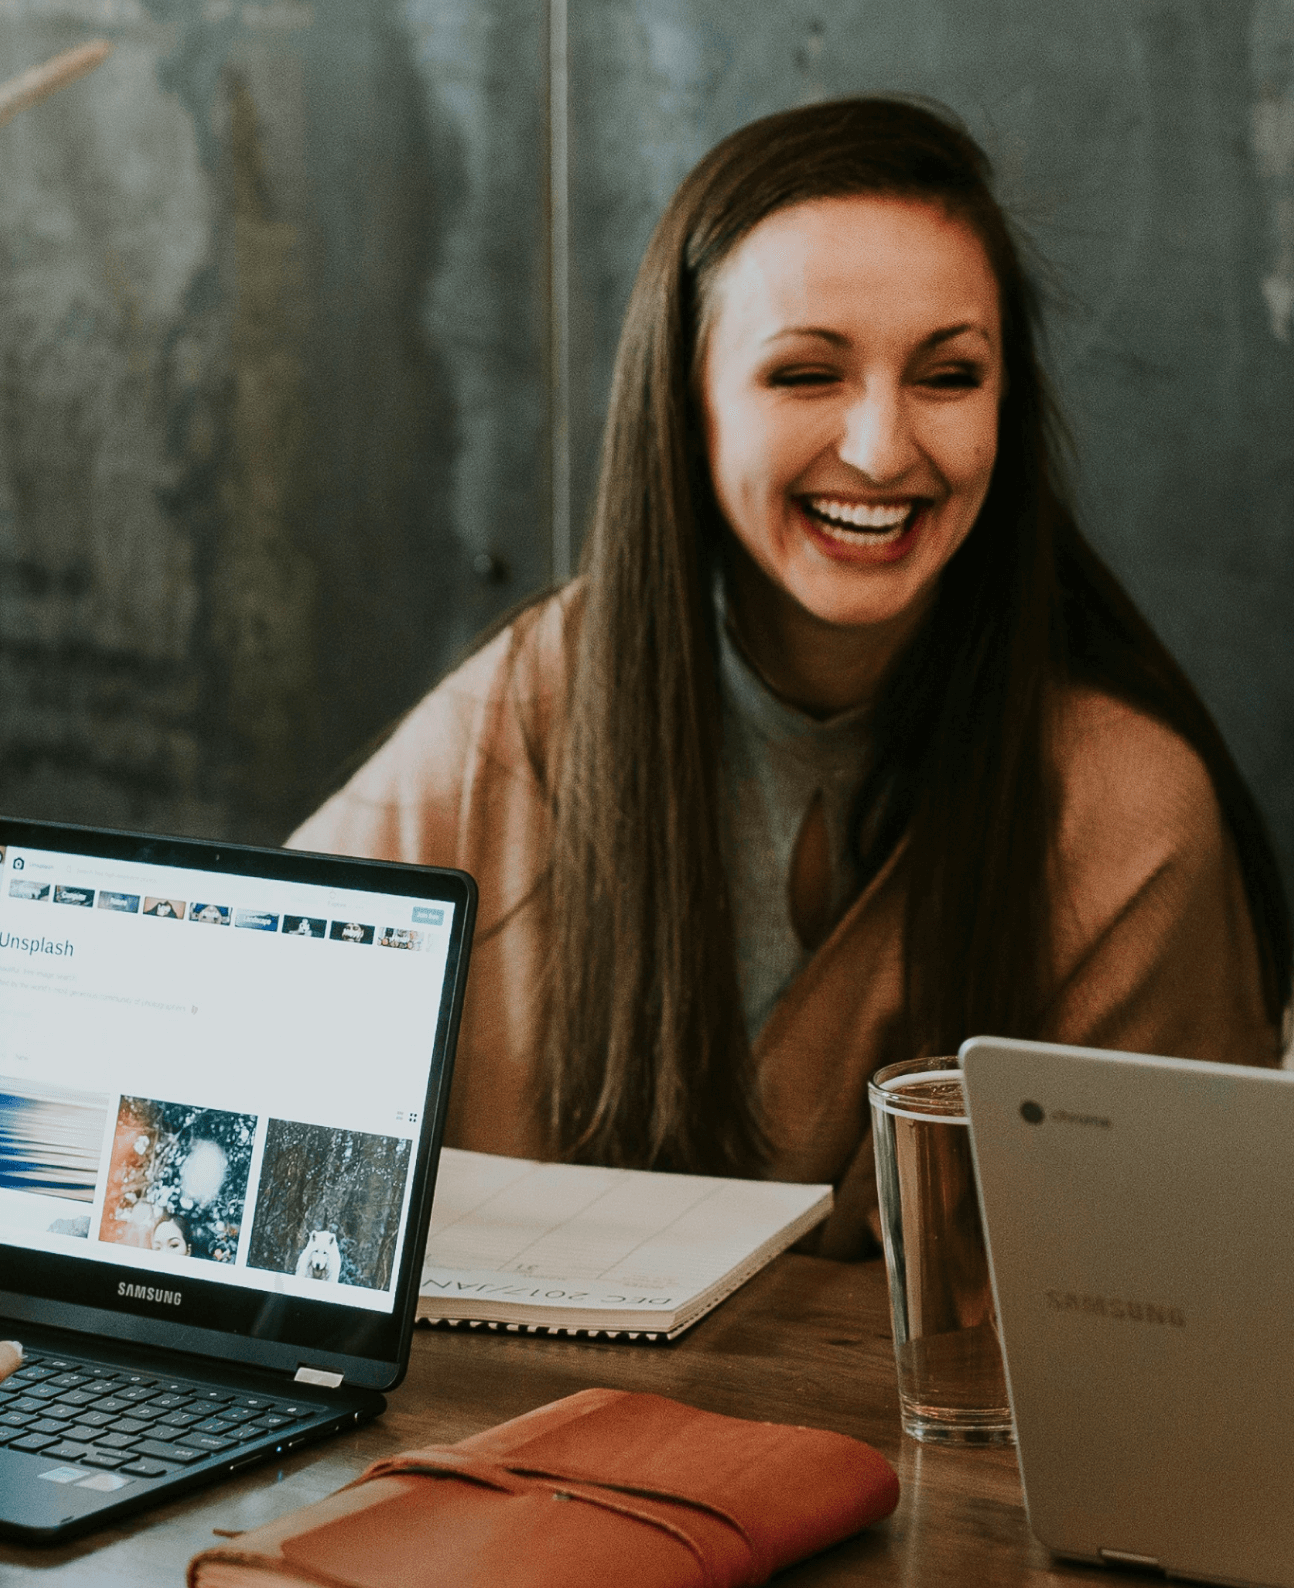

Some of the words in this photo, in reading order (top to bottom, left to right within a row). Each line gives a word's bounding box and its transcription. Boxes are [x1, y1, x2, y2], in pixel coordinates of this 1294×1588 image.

[0, 931, 74, 957] Unsplash
[117, 1281, 182, 1306] SAMSUNG
[600, 1295, 672, 1305] DEC
[1045, 1289, 1187, 1328] SAMSUNG
